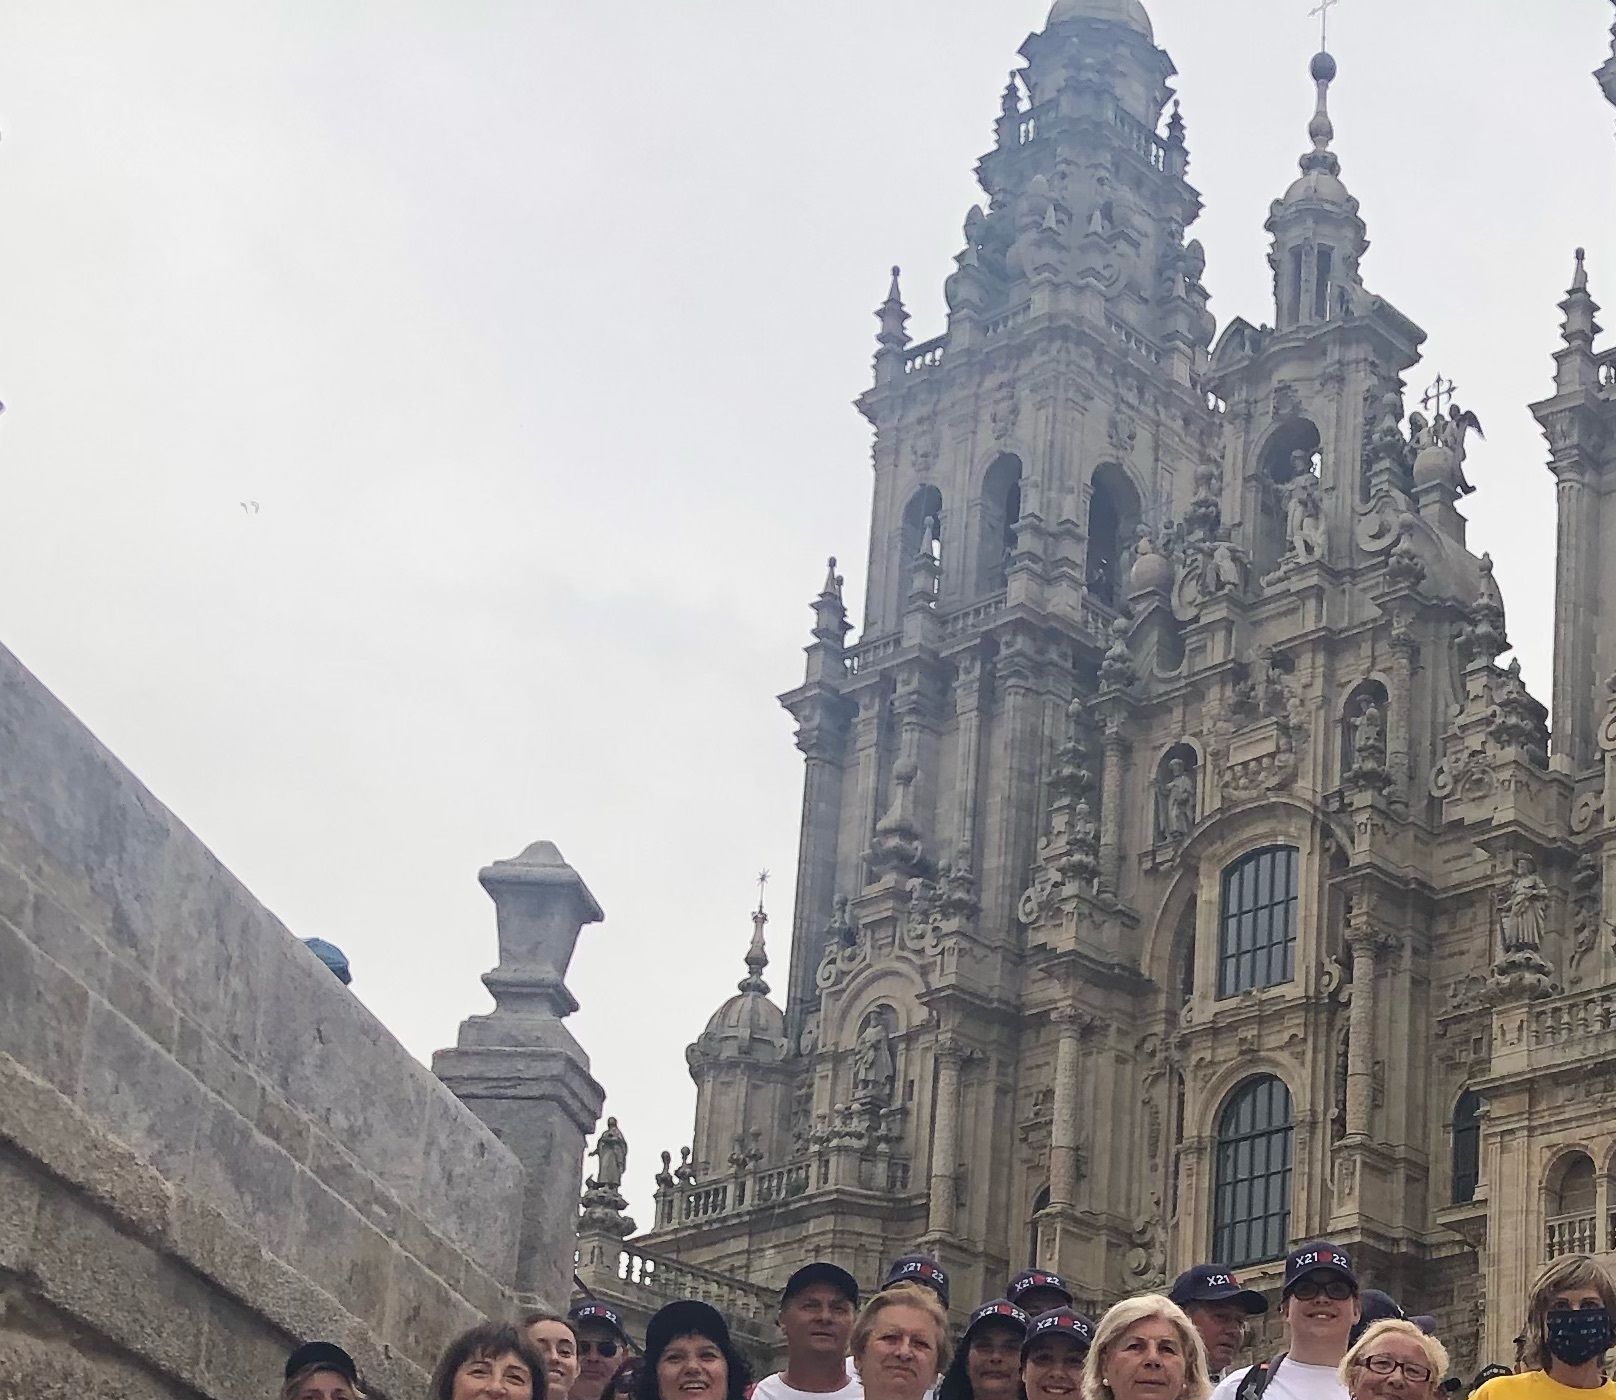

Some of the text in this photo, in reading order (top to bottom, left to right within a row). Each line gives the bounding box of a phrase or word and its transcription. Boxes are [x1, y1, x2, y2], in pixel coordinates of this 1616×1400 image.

[1296, 1252, 1348, 1268] X21 22
[931, 1269, 944, 1284] 22
[1015, 1276, 1060, 1292] X21 22
[1207, 1275, 1229, 1287] X21
[1036, 1317, 1088, 1336] X21 22
